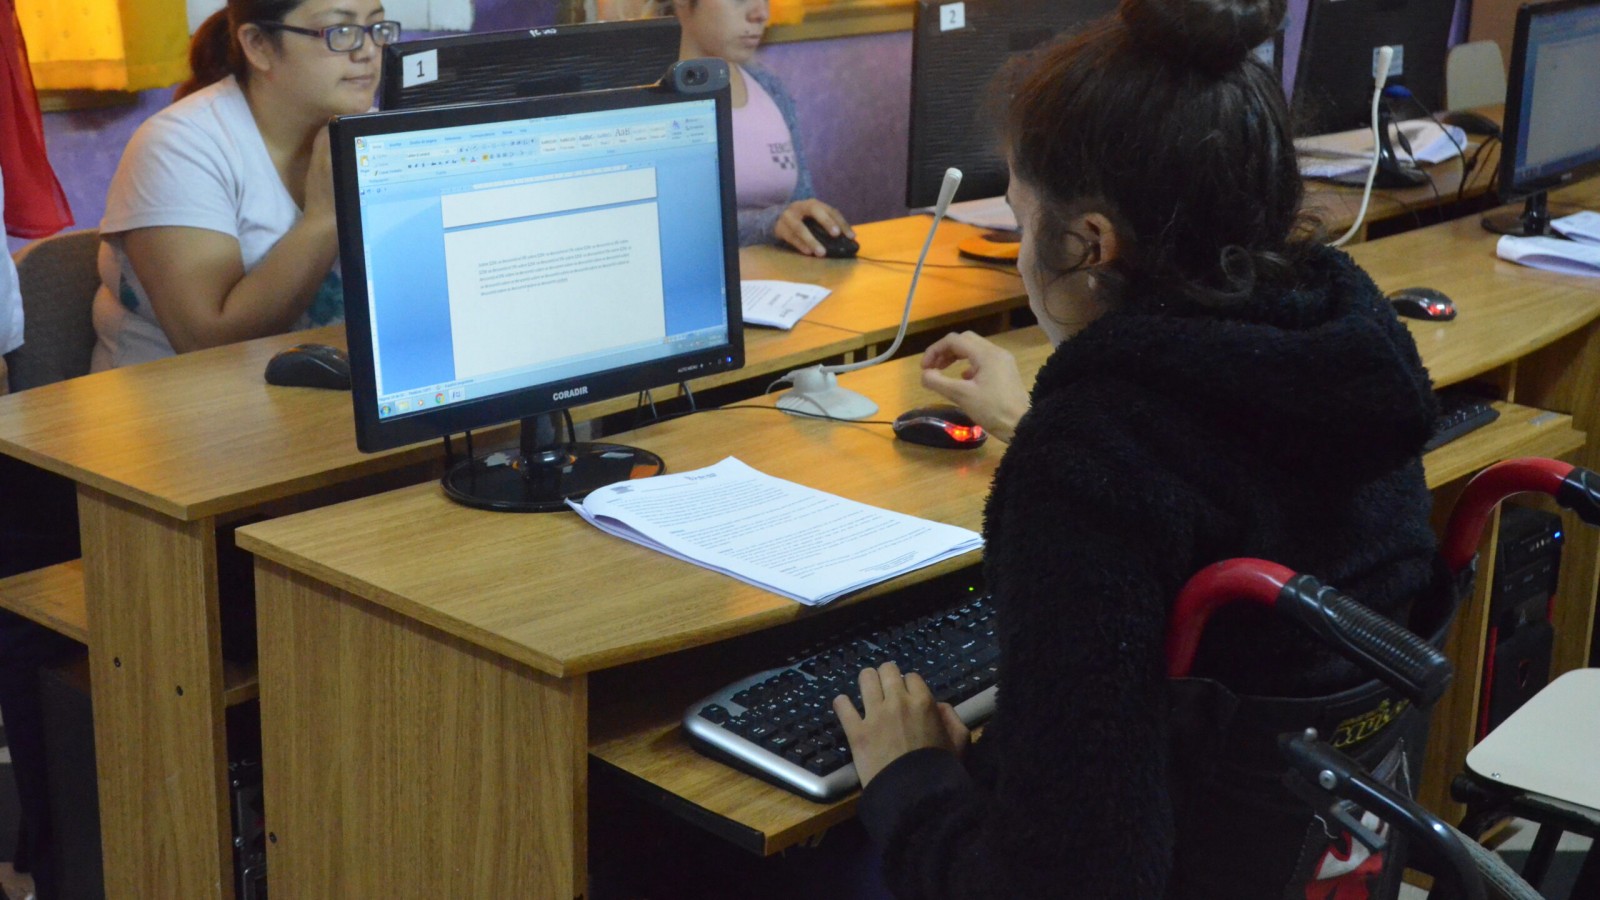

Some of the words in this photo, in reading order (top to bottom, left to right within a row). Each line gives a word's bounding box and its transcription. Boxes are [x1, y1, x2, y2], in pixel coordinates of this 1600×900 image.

[949, 9, 957, 24] 2
[416, 59, 425, 78] 1
[552, 385, 589, 401] CORADIR
